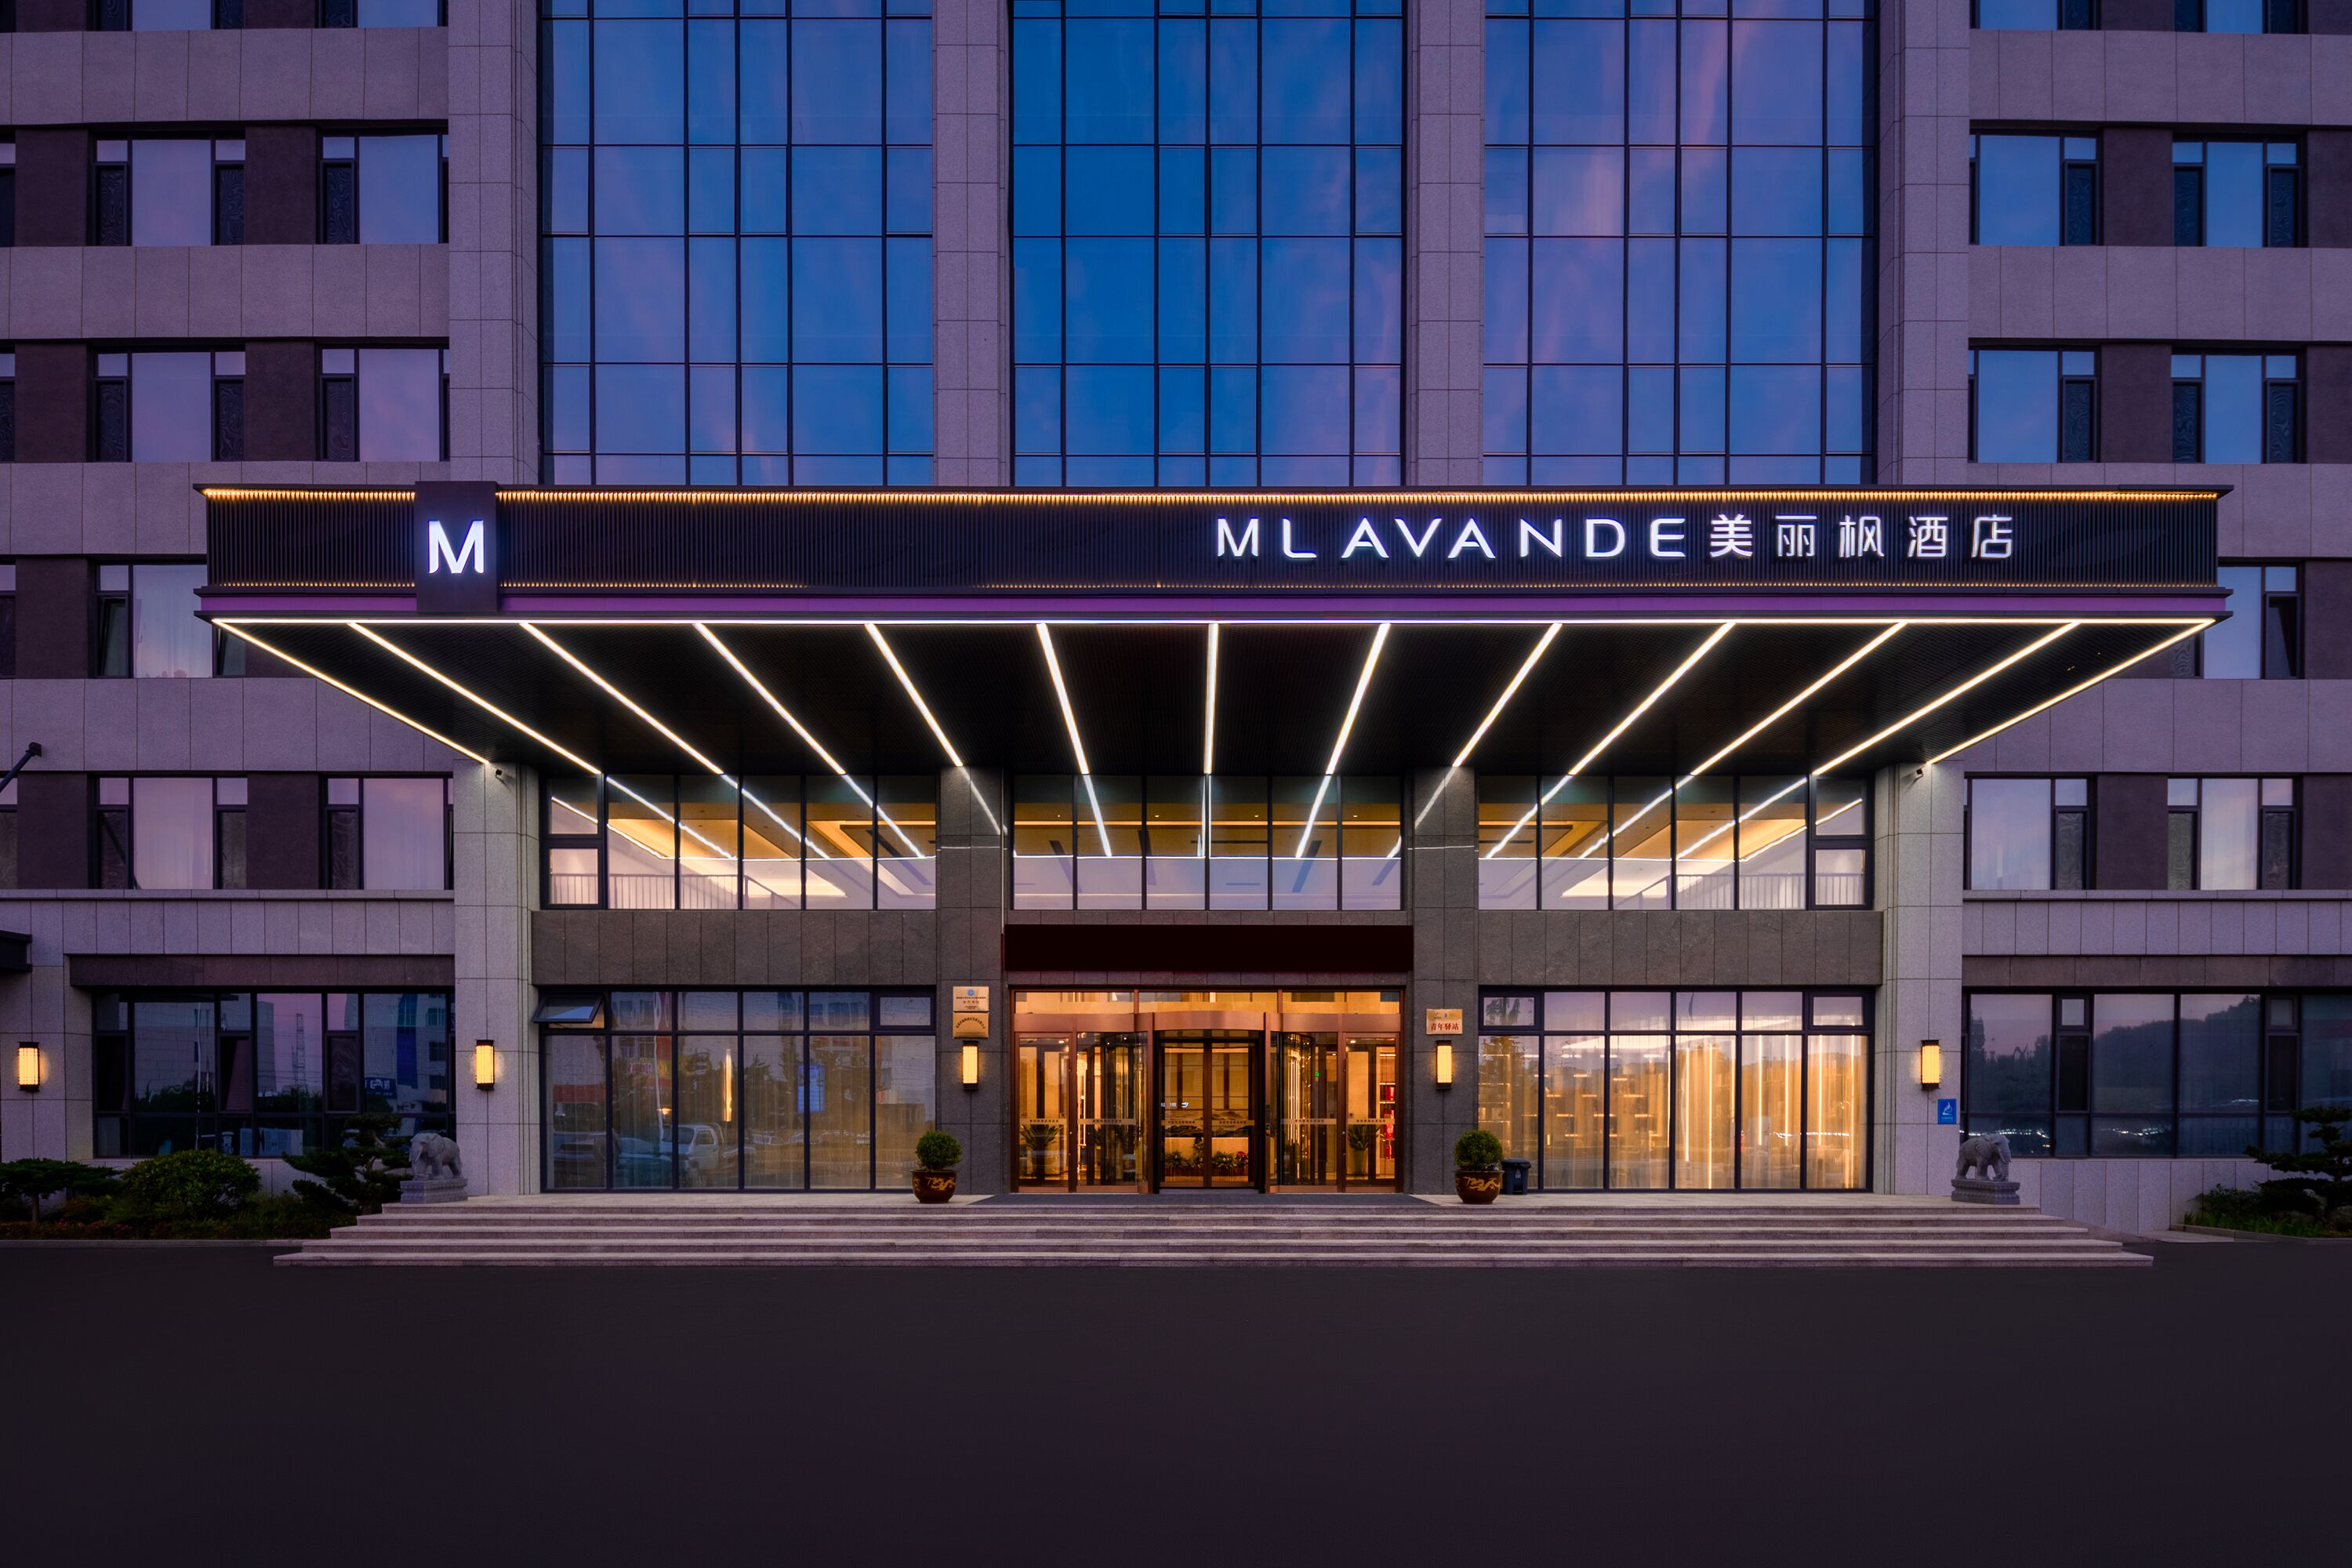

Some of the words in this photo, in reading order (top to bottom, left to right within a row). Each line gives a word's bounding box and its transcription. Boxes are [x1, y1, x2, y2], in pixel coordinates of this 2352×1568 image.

[428, 520, 485, 574] M
[1709, 514, 2013, 559] 美丽枫酒店
